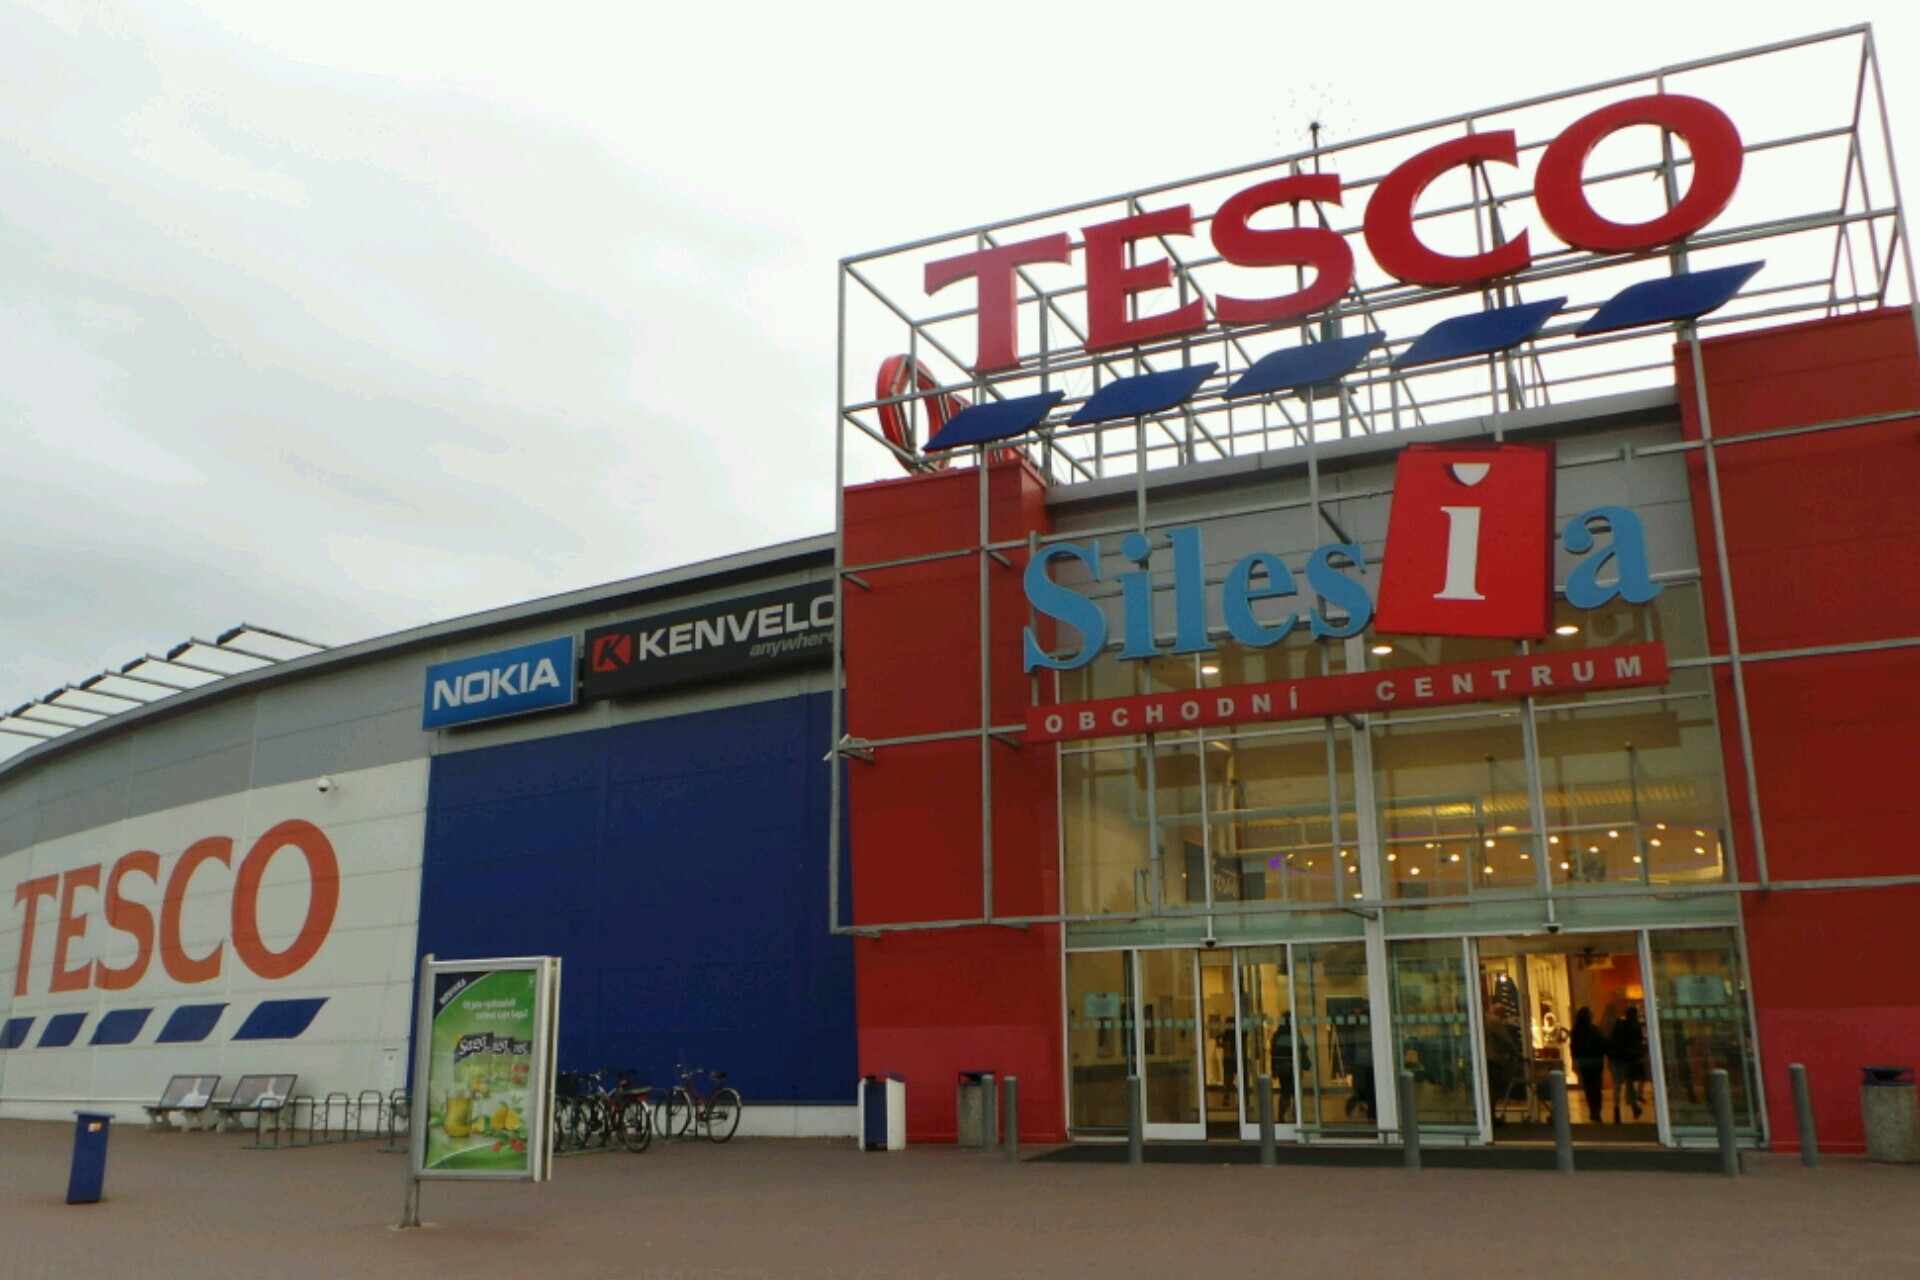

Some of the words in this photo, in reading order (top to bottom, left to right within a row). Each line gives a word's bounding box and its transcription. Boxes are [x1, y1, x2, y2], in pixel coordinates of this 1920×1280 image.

[924, 94, 1745, 372] TESCO
[1022, 463, 1665, 673] Silesia
[432, 658, 560, 711] NOKIA
[1044, 685, 1299, 734] OBCHODNÍ
[1376, 655, 1642, 702] CENTRUM
[14, 819, 340, 997] TESCO
